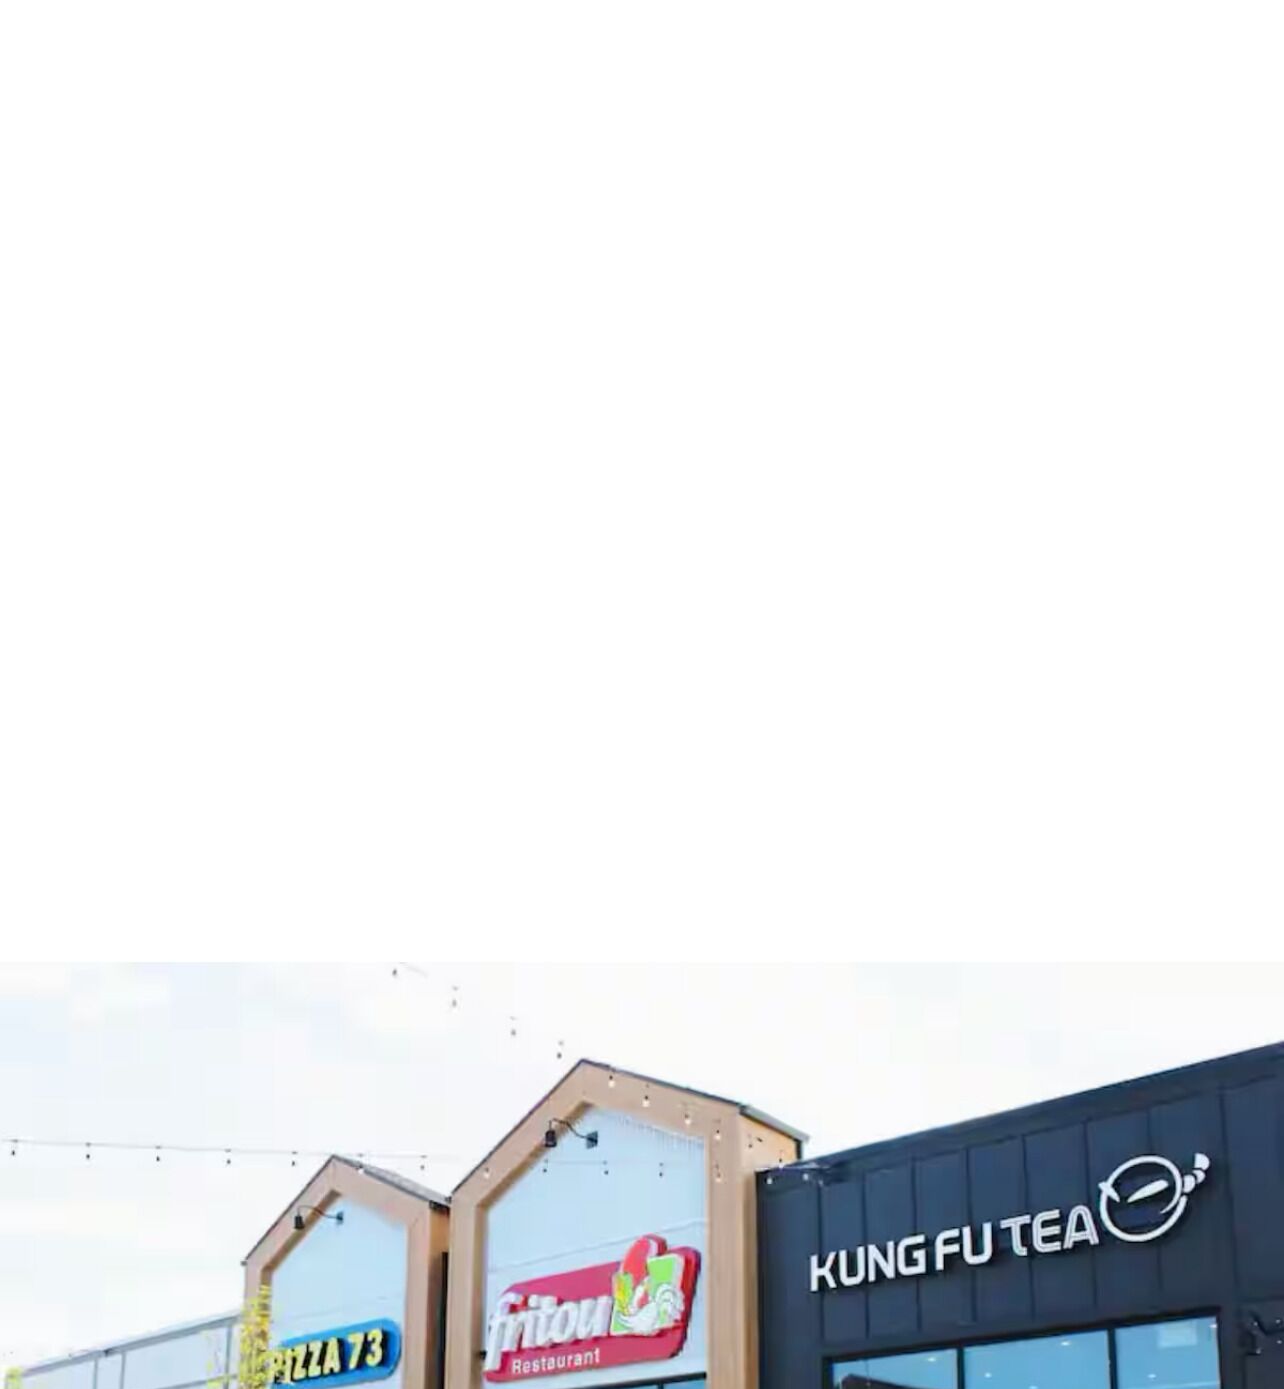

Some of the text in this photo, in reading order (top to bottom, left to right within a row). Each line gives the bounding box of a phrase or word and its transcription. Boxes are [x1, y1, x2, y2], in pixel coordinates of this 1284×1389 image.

[809, 1204, 1099, 1292] KUNG FU TEA
[272, 1328, 385, 1384] PIZZA 73
[483, 1290, 613, 1372] fritou
[511, 1347, 600, 1375] Restaurant
